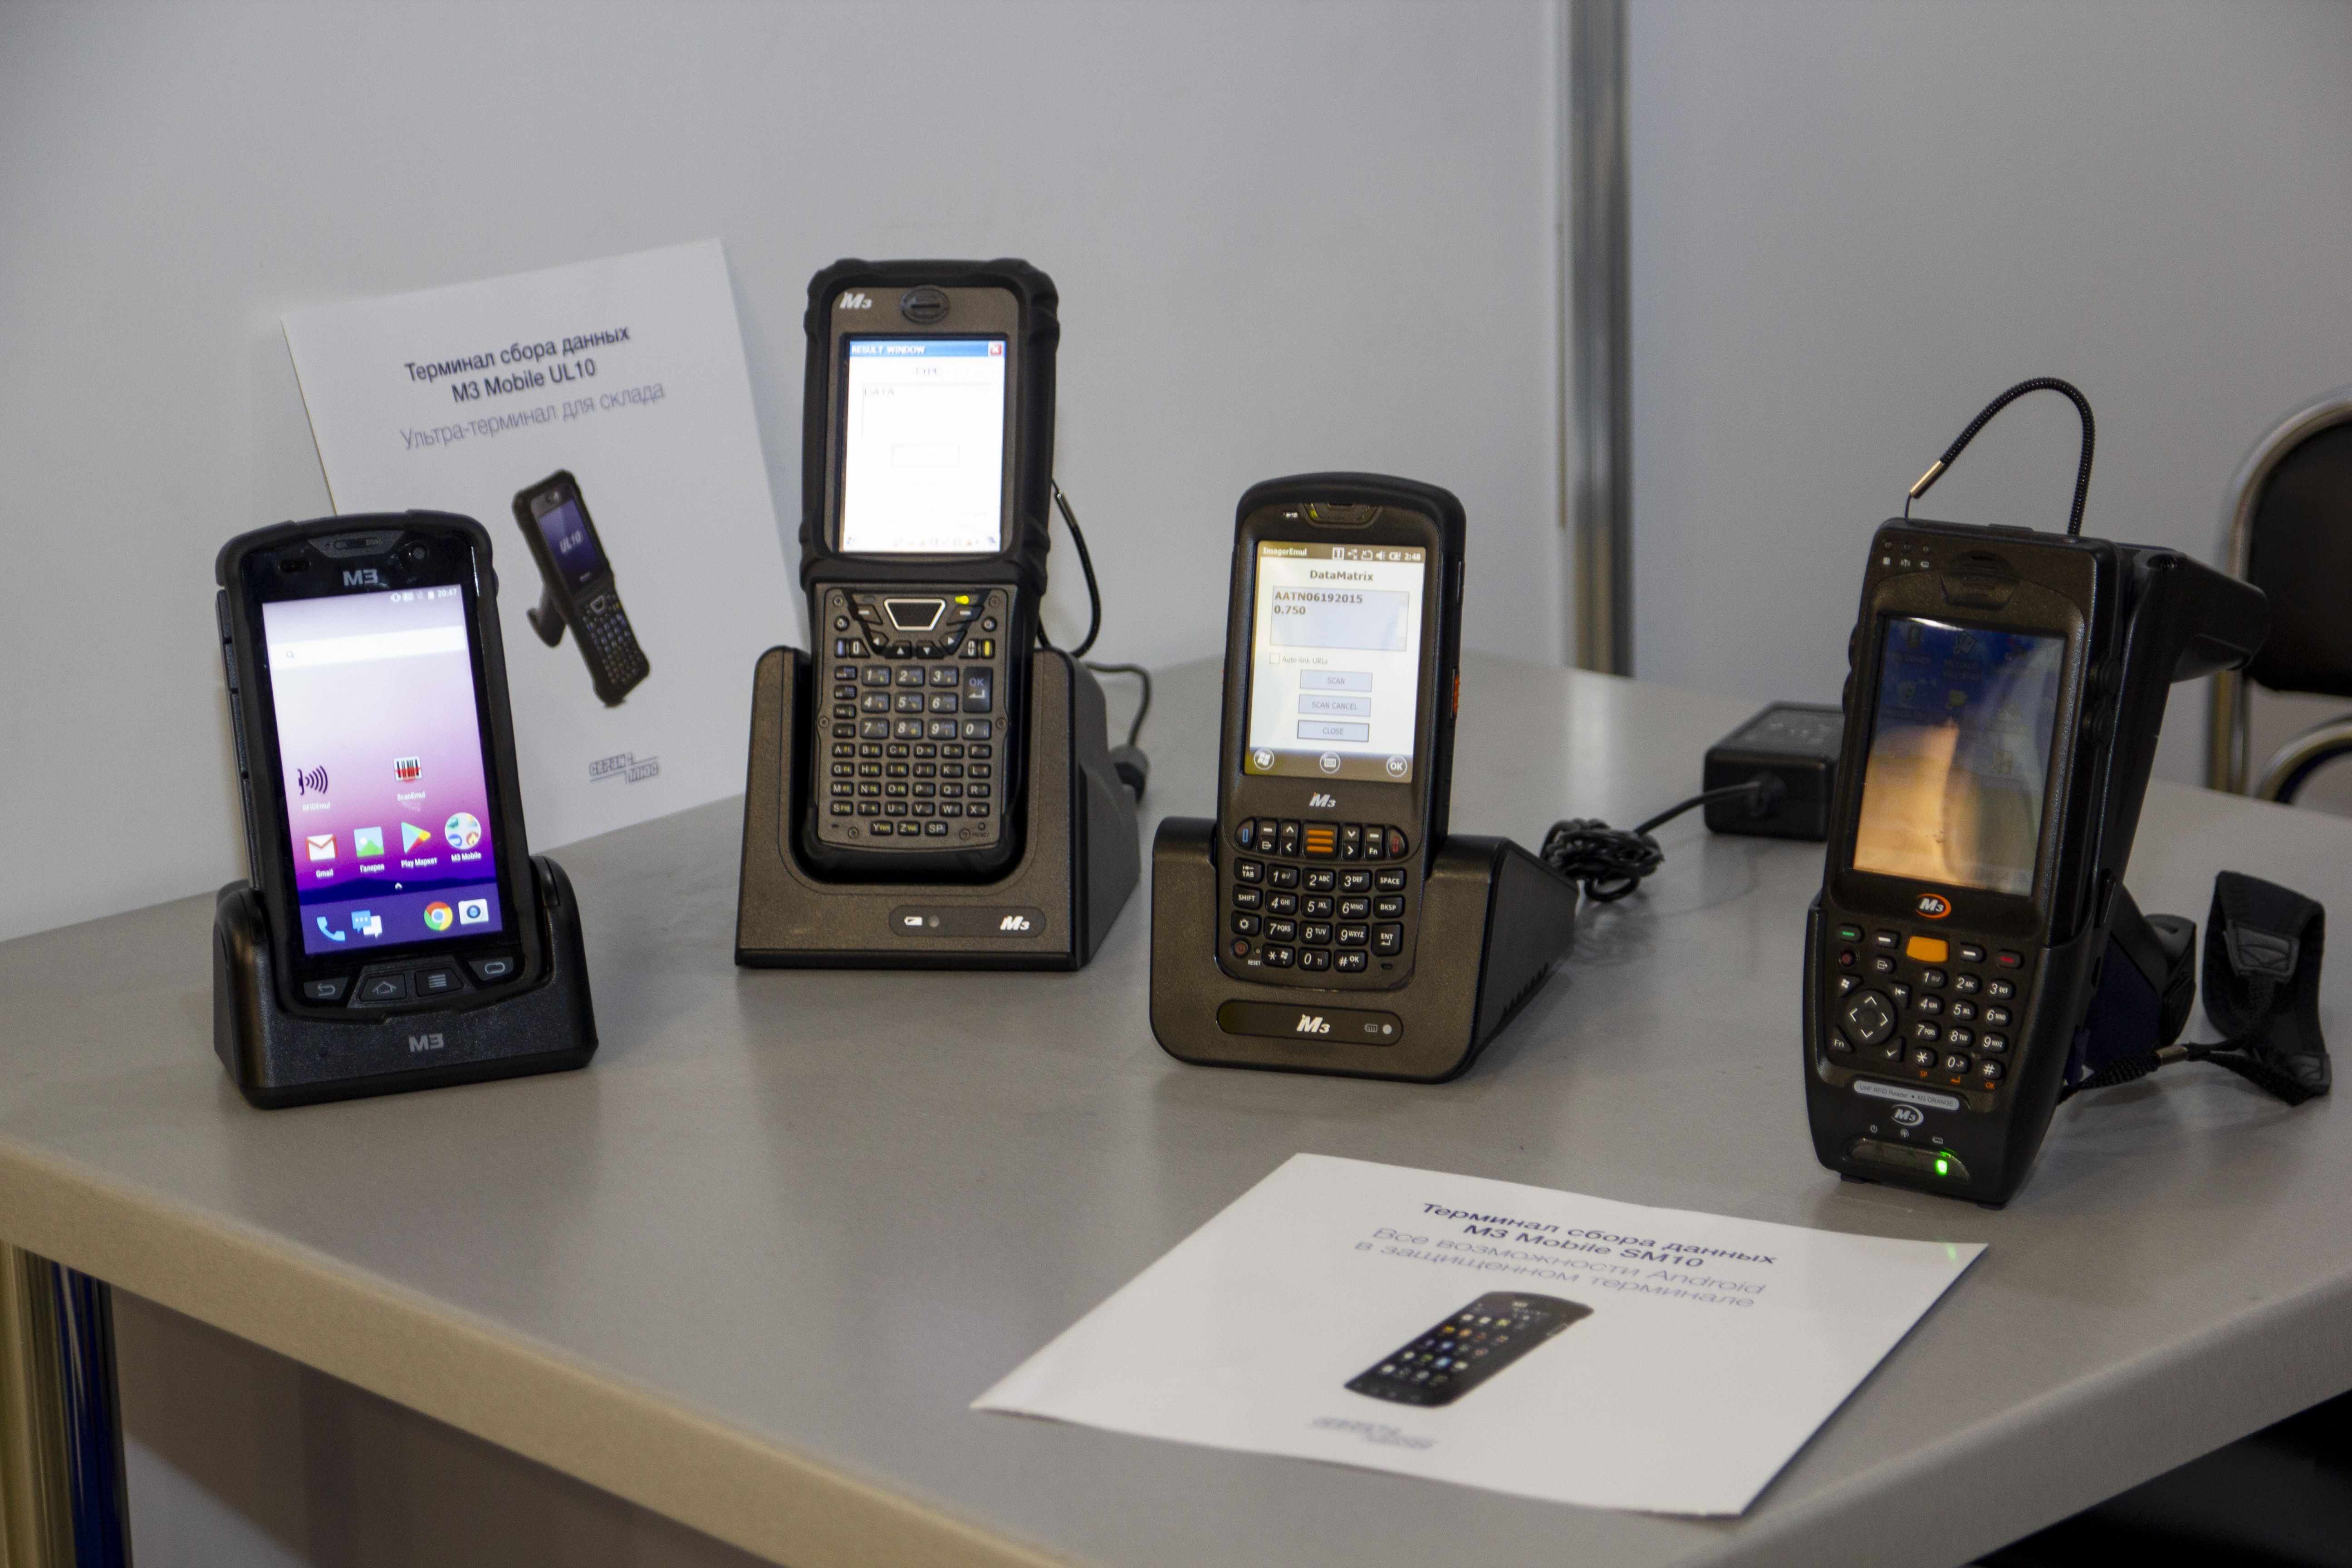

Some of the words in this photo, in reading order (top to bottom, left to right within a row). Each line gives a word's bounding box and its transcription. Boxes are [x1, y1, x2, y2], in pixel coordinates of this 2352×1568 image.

[839, 292, 872, 309] M3
[406, 352, 495, 382] Терминал
[501, 342, 557, 364] сбора
[562, 326, 630, 355] данных
[887, 346, 925, 354] WINDOW
[452, 381, 480, 402] M3
[485, 369, 544, 397] Mobile
[549, 359, 596, 384] UL10
[400, 404, 556, 450] Ультра-терминал
[563, 397, 595, 421] для
[599, 383, 665, 409] склада
[1263, 547, 1307, 557] ImagerEmul
[343, 569, 378, 586] M3
[1310, 570, 1373, 581] DataMatrix
[1275, 591, 1363, 603] AATN06192015
[1274, 606, 1306, 615] 0.750
[867, 671, 872, 681] 1
[900, 671, 907, 681] 2
[934, 671, 941, 682] 3
[969, 678, 984, 686] OK
[864, 696, 872, 707] 4
[898, 697, 906, 707] 5
[932, 697, 940, 708] 6
[865, 722, 872, 734] 7
[898, 722, 905, 734] 8
[931, 723, 939, 735] 9
[966, 723, 974, 734] 0
[1390, 762, 1403, 770] OK
[397, 791, 425, 801] ScanEmul
[1309, 792, 1336, 808] M3
[451, 854, 460, 862] M3
[461, 852, 481, 861] Mobile
[360, 863, 384, 873] Галерея
[401, 860, 414, 869] Play
[316, 869, 333, 878] Gmail
[1274, 871, 1278, 882] 1
[1309, 875, 1316, 885] 2
[1345, 876, 1351, 887] 3
[1272, 898, 1278, 908] 4
[1308, 901, 1314, 911] 5
[1343, 902, 1349, 913] 6
[1920, 898, 1944, 912] M3
[1000, 916, 1030, 930] M3
[1270, 923, 1276, 934] 7
[1306, 928, 1313, 938] 8
[1341, 929, 1347, 940] 9
[1304, 954, 1311, 964] 0
[1925, 972, 1929, 982] 1
[1957, 978, 1964, 989] 2
[1990, 984, 1997, 994] 3
[1921, 999, 1927, 1009] 4
[1954, 1004, 1961, 1015] 5
[1987, 1010, 1994, 1020] 6
[1296, 1014, 1330, 1034] M3
[1917, 1025, 1924, 1035] 7
[1951, 1031, 1958, 1041] 8
[408, 1033, 444, 1051] M3
[1834, 1039, 1844, 1048] Fn
[1984, 1037, 1991, 1048] 9
[1948, 1058, 1955, 1067] 0
[1927, 1097, 1954, 1106] ORANGE
[1894, 1109, 1916, 1121] M3
[1423, 1203, 1559, 1233] Терминал
[1567, 1227, 1656, 1248] сбора
[1661, 1238, 1778, 1265] данных
[1463, 1225, 1508, 1239] M3
[1515, 1230, 1611, 1256] Mobile
[1621, 1247, 1705, 1268] SM10
[1372, 1227, 1429, 1245] Все
[1436, 1238, 1639, 1277] возможности
[1646, 1269, 1767, 1295] Android
[1380, 1246, 1582, 1283] защищенном
[1589, 1275, 1756, 1308] терминале
